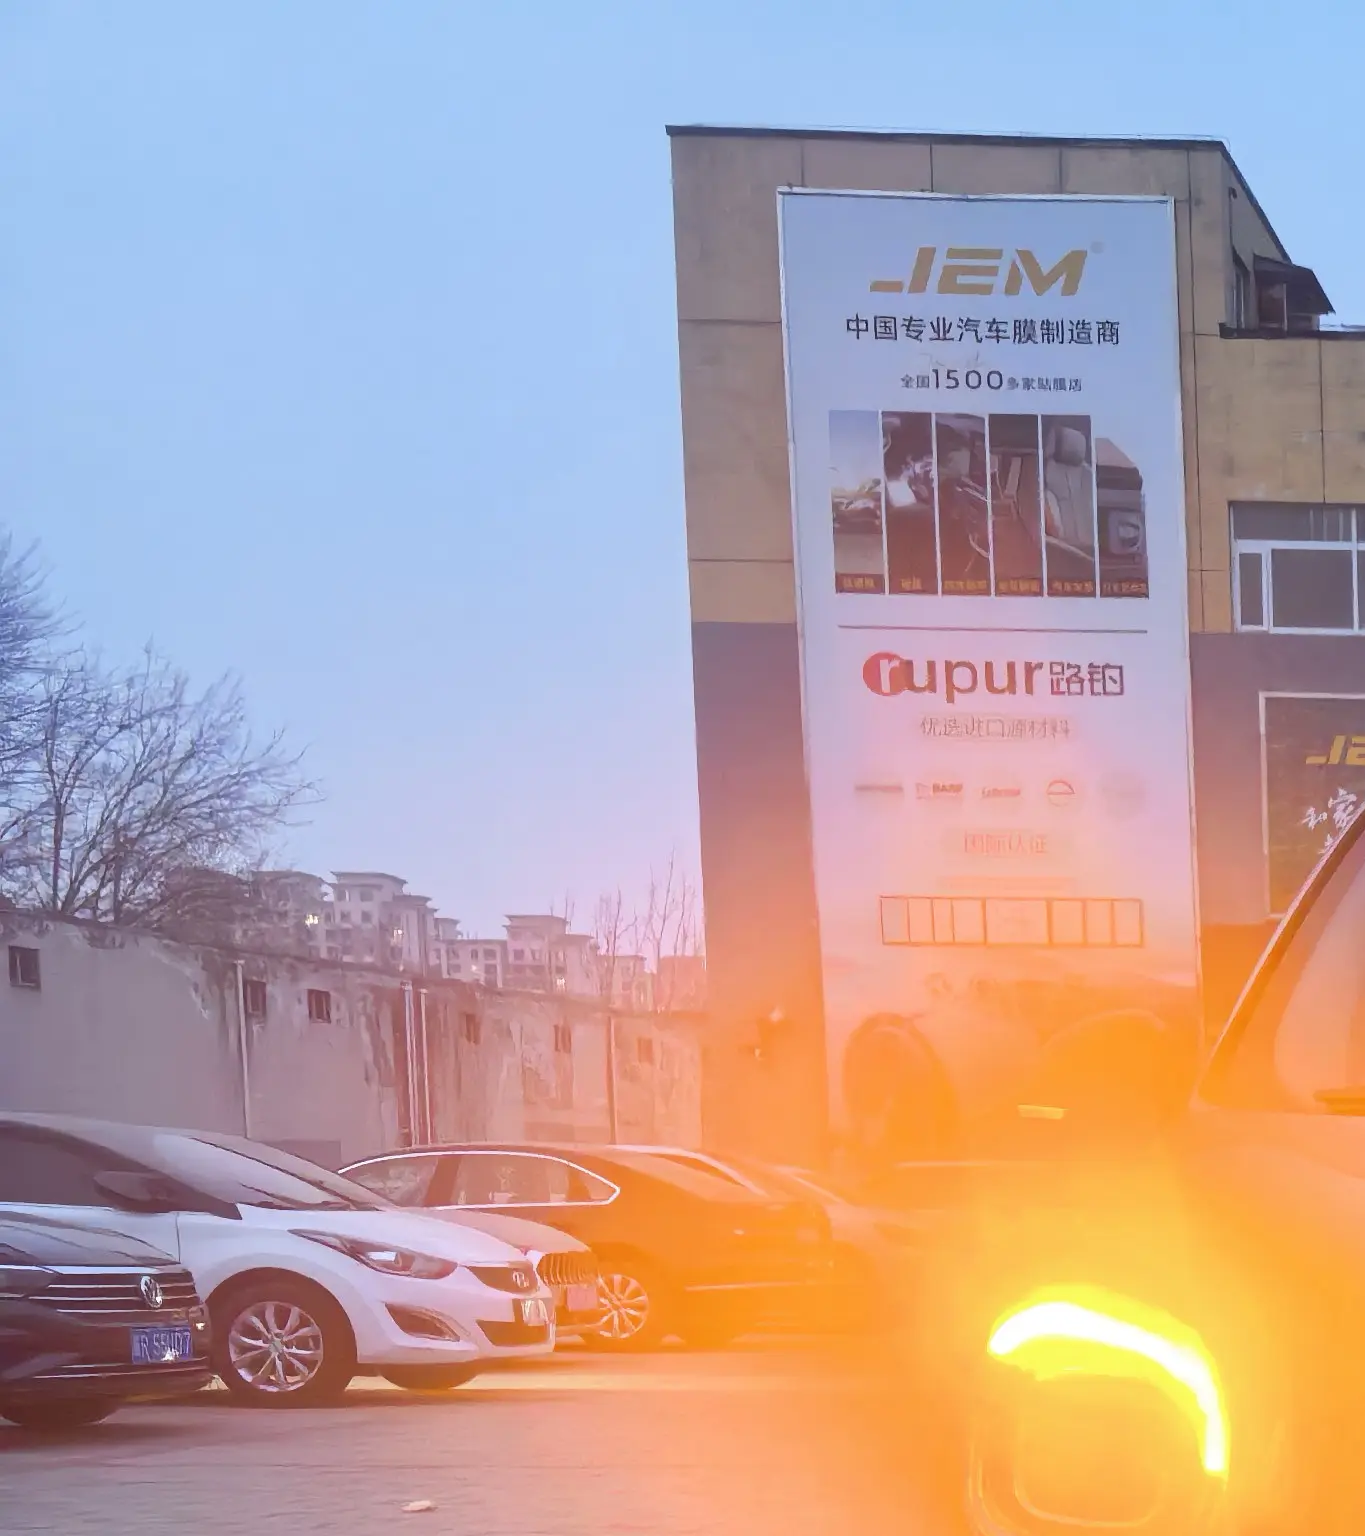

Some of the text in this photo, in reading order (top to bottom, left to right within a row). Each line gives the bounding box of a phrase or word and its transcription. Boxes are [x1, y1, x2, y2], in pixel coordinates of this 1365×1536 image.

[870, 246, 1087, 297] JEM
[847, 313, 1120, 345] 中国专业汽车膜制造商
